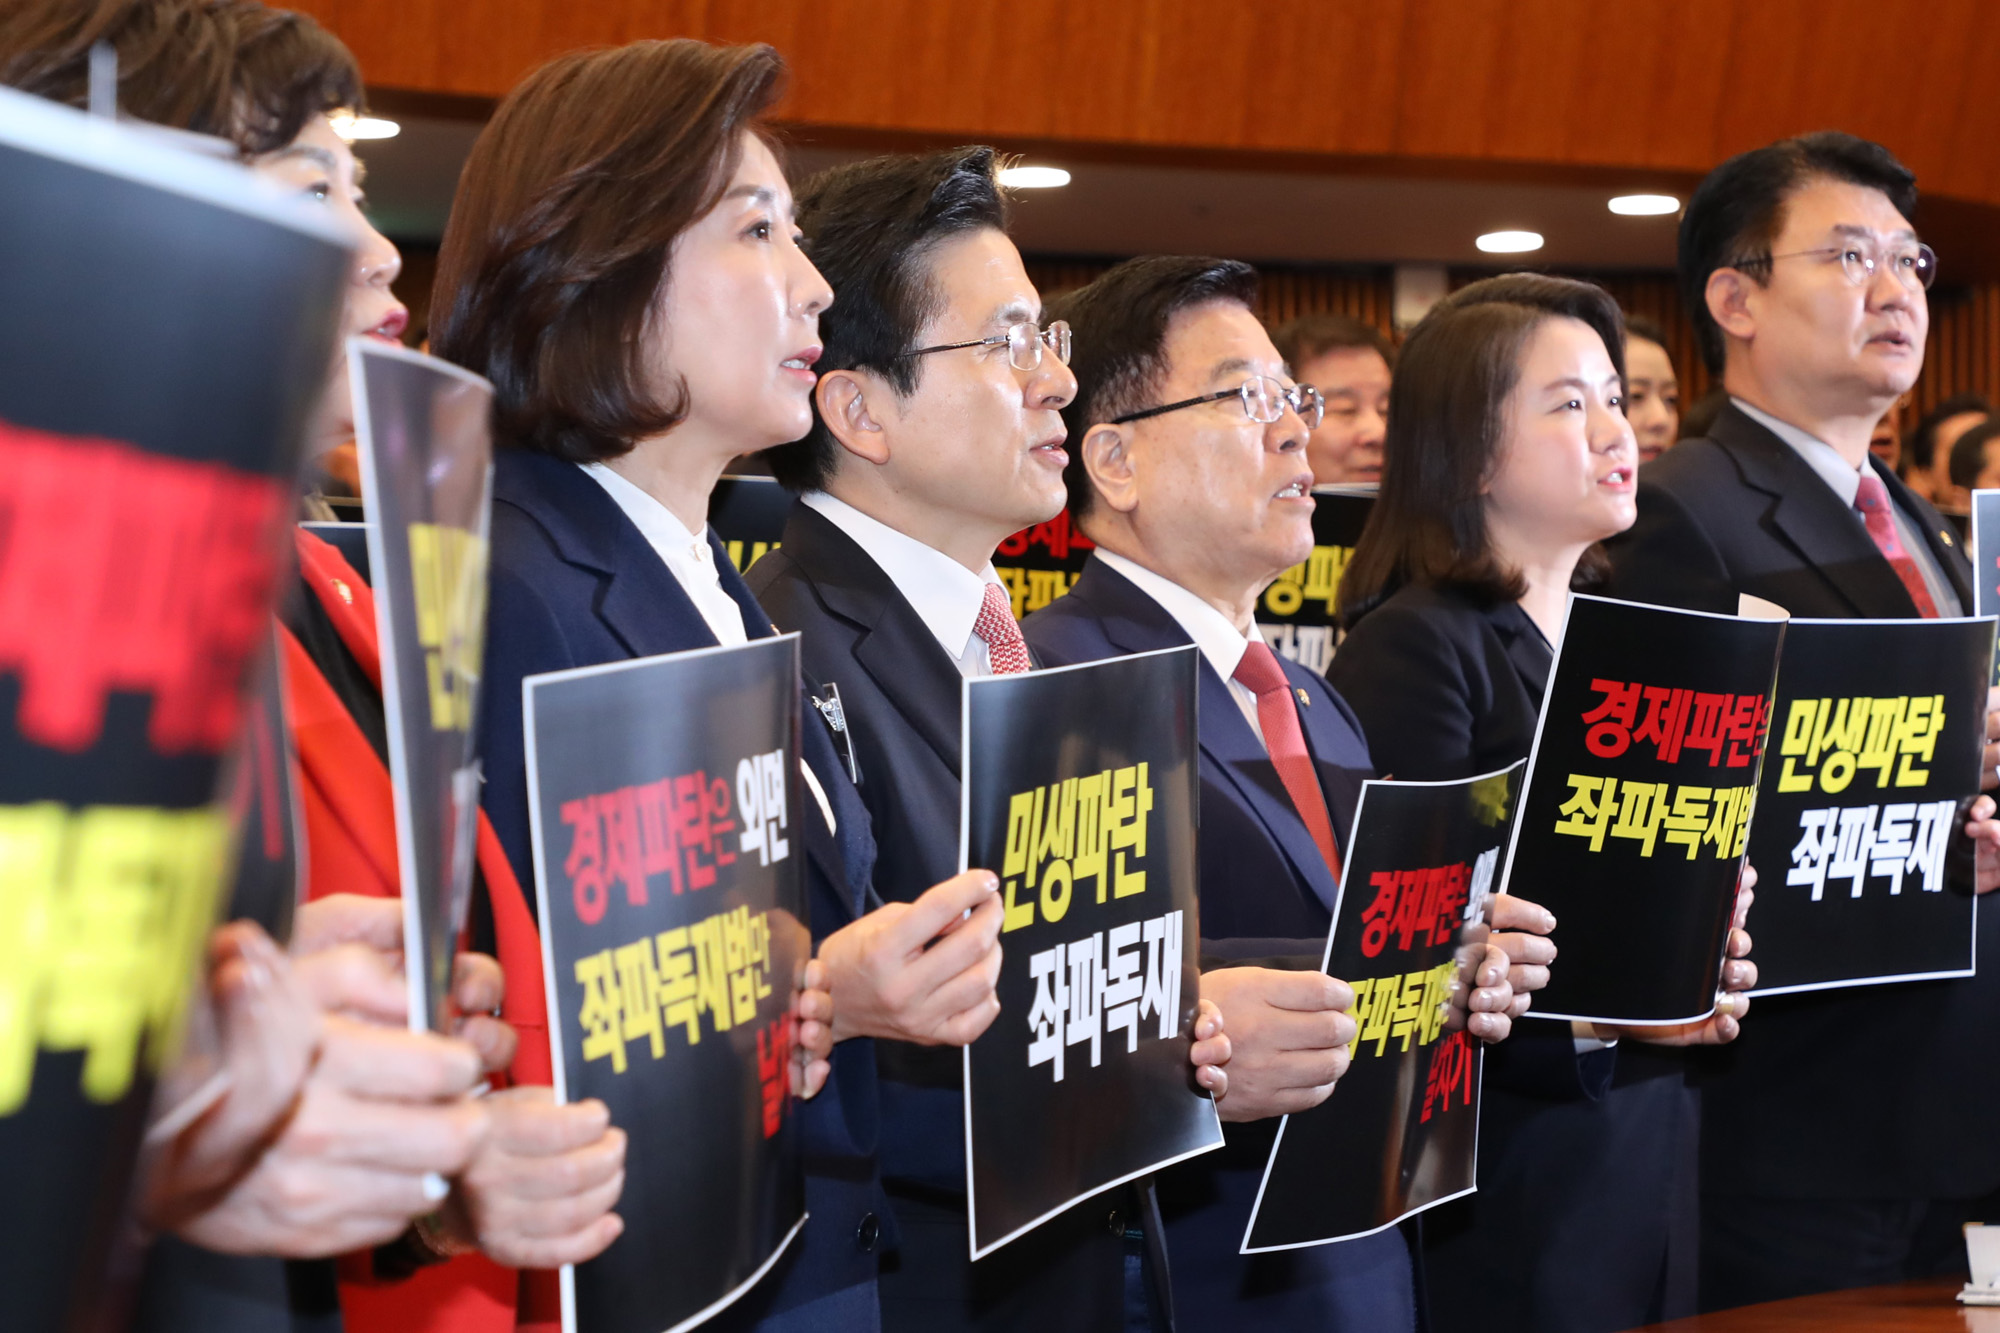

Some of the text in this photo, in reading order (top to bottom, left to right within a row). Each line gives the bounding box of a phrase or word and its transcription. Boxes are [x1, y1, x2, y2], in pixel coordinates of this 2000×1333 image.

[1777, 694, 1945, 793] 민생파탄
[560, 769, 736, 925] 경제파탄은
[736, 748, 789, 867] 외면
[1002, 761, 1153, 933] 민생파탄
[1786, 800, 1957, 901] 좌파독재
[574, 904, 770, 1074] 좌파독재법만
[1027, 909, 1184, 1083] 좌파독재
